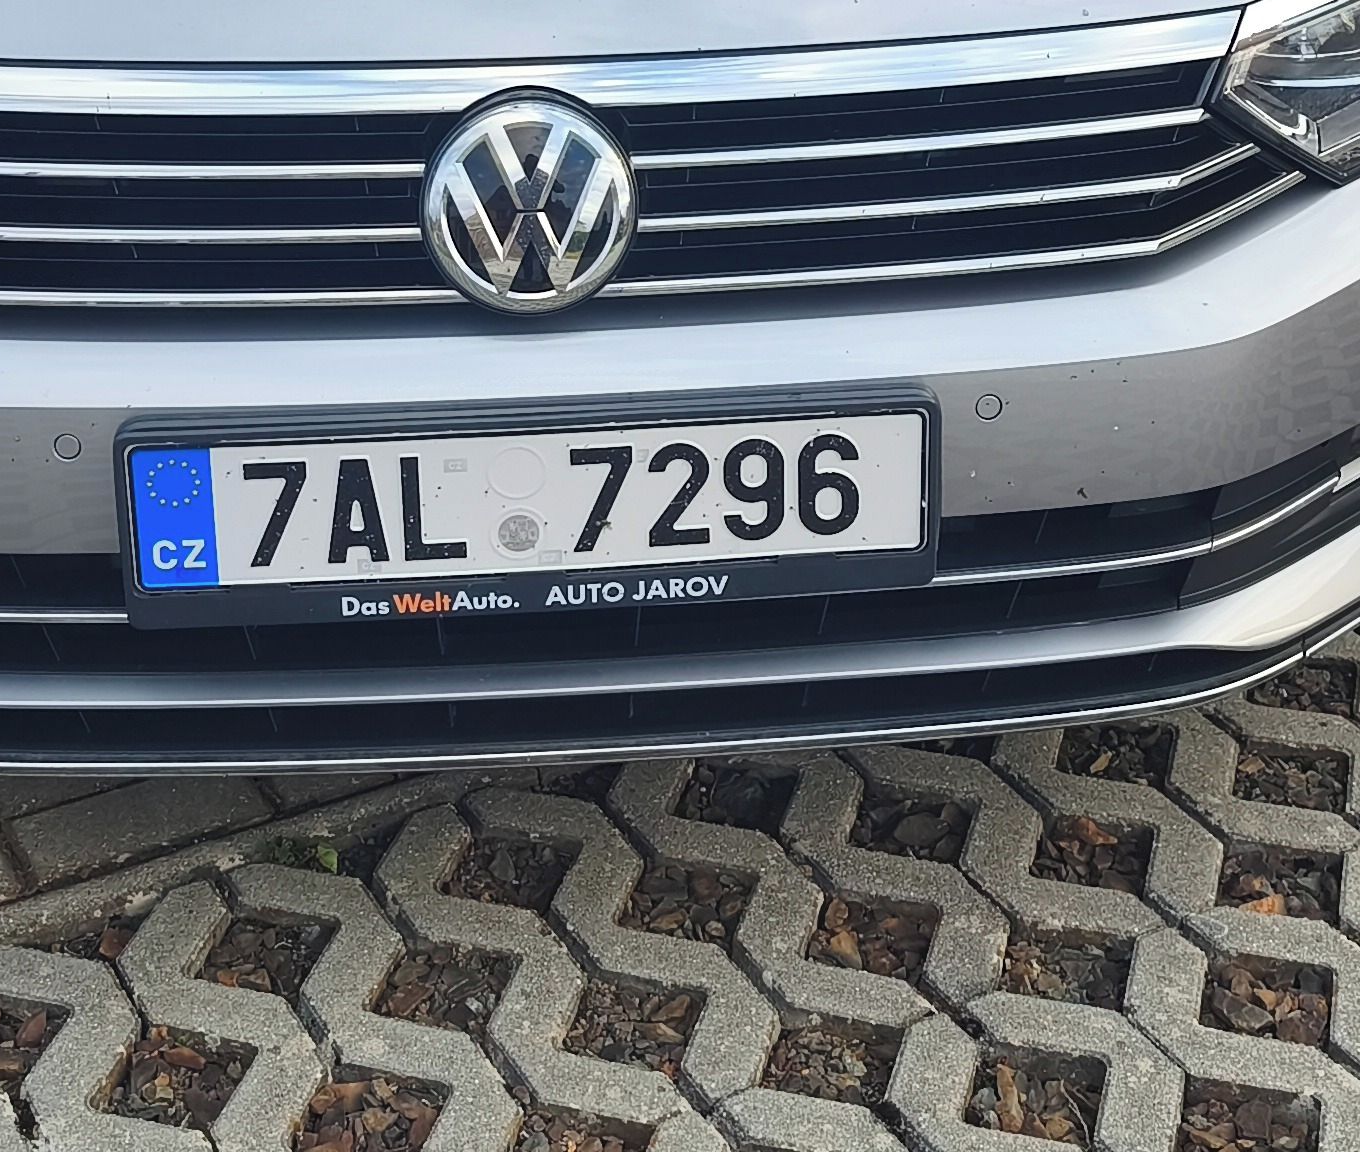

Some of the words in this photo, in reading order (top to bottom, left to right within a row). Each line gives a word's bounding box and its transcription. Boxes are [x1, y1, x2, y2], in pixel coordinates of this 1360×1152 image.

[242, 455, 468, 568] 7AL
[569, 433, 860, 553] 7296
[151, 538, 207, 570] CZ
[341, 596, 390, 617] Das
[392, 591, 521, 615] WeltAuto.
[544, 581, 625, 606] AUTO
[631, 575, 729, 601] JAROV
